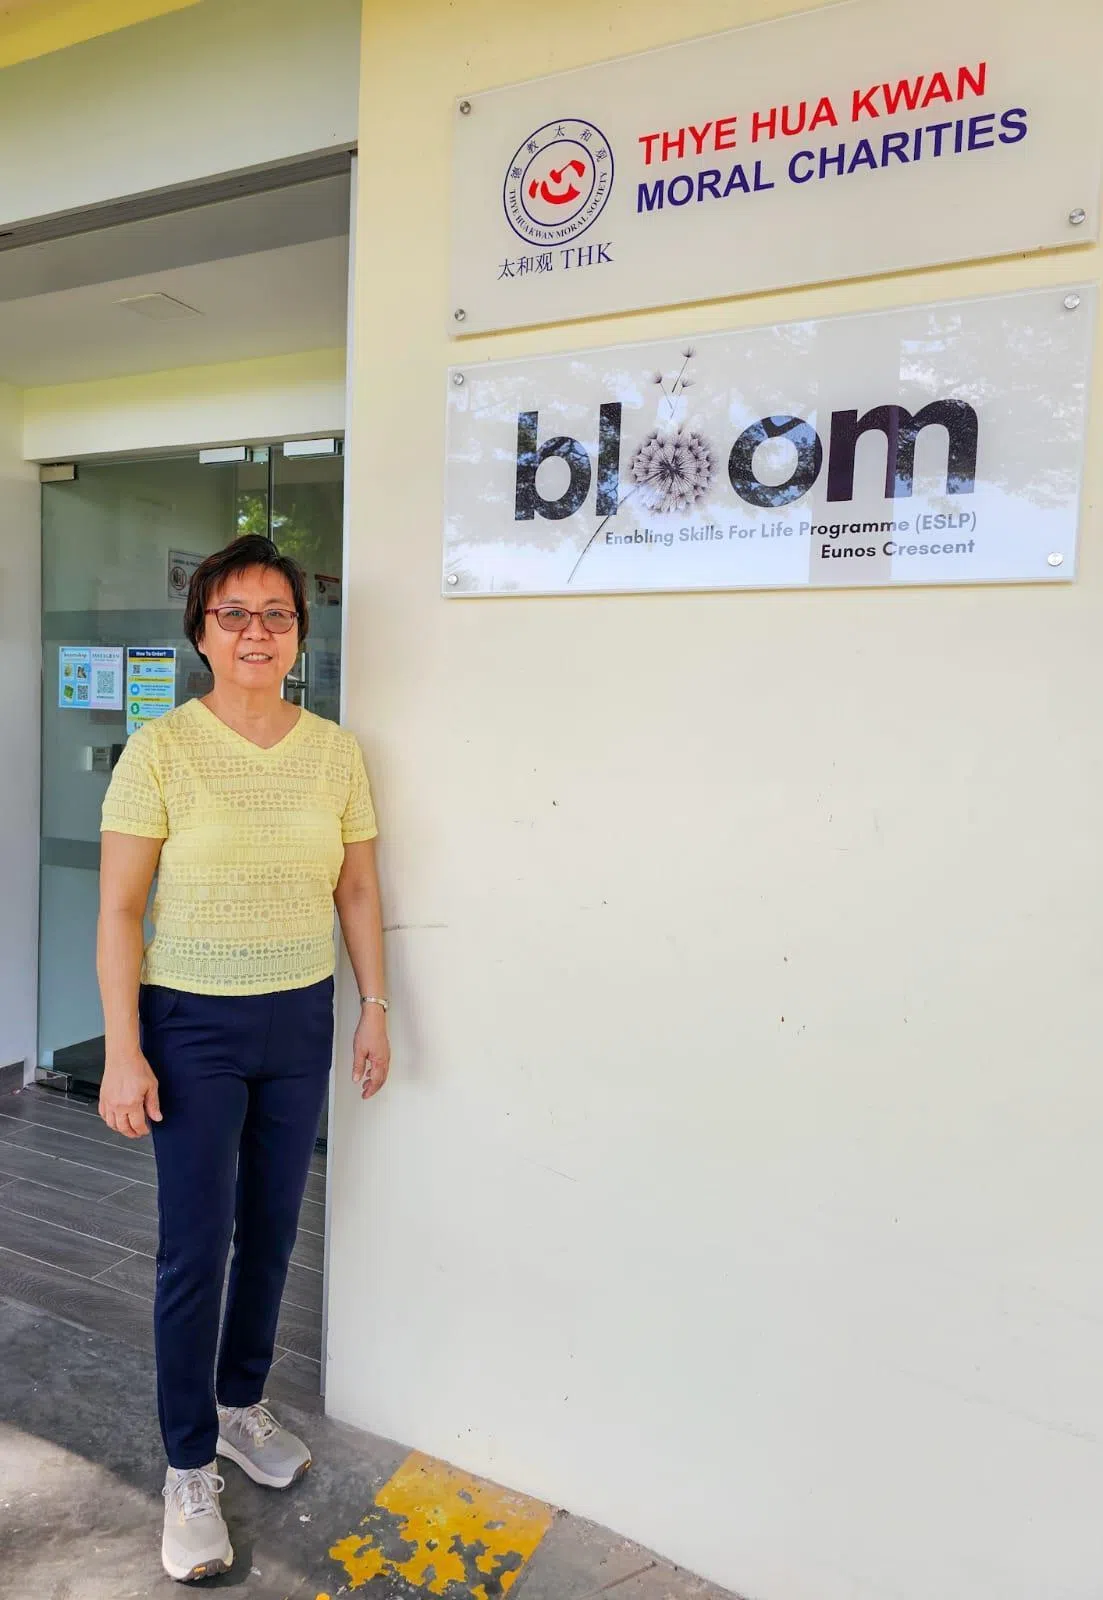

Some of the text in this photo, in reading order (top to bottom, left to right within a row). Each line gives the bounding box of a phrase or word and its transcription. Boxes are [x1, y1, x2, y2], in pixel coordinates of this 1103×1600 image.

[639, 62, 987, 165] THYE HUA KWAN
[636, 107, 1028, 213] MORAL CHARITIES
[509, 189, 518, 217] THYE
[556, 216, 589, 238] MORAL
[587, 172, 608, 217] SOCIETY
[497, 252, 553, 281] 太和观
[560, 241, 615, 270] THK
[605, 511, 978, 547] Enabling Skills For Life Programme (ESLP)
[820, 539, 976, 559] Eunos Crescent
